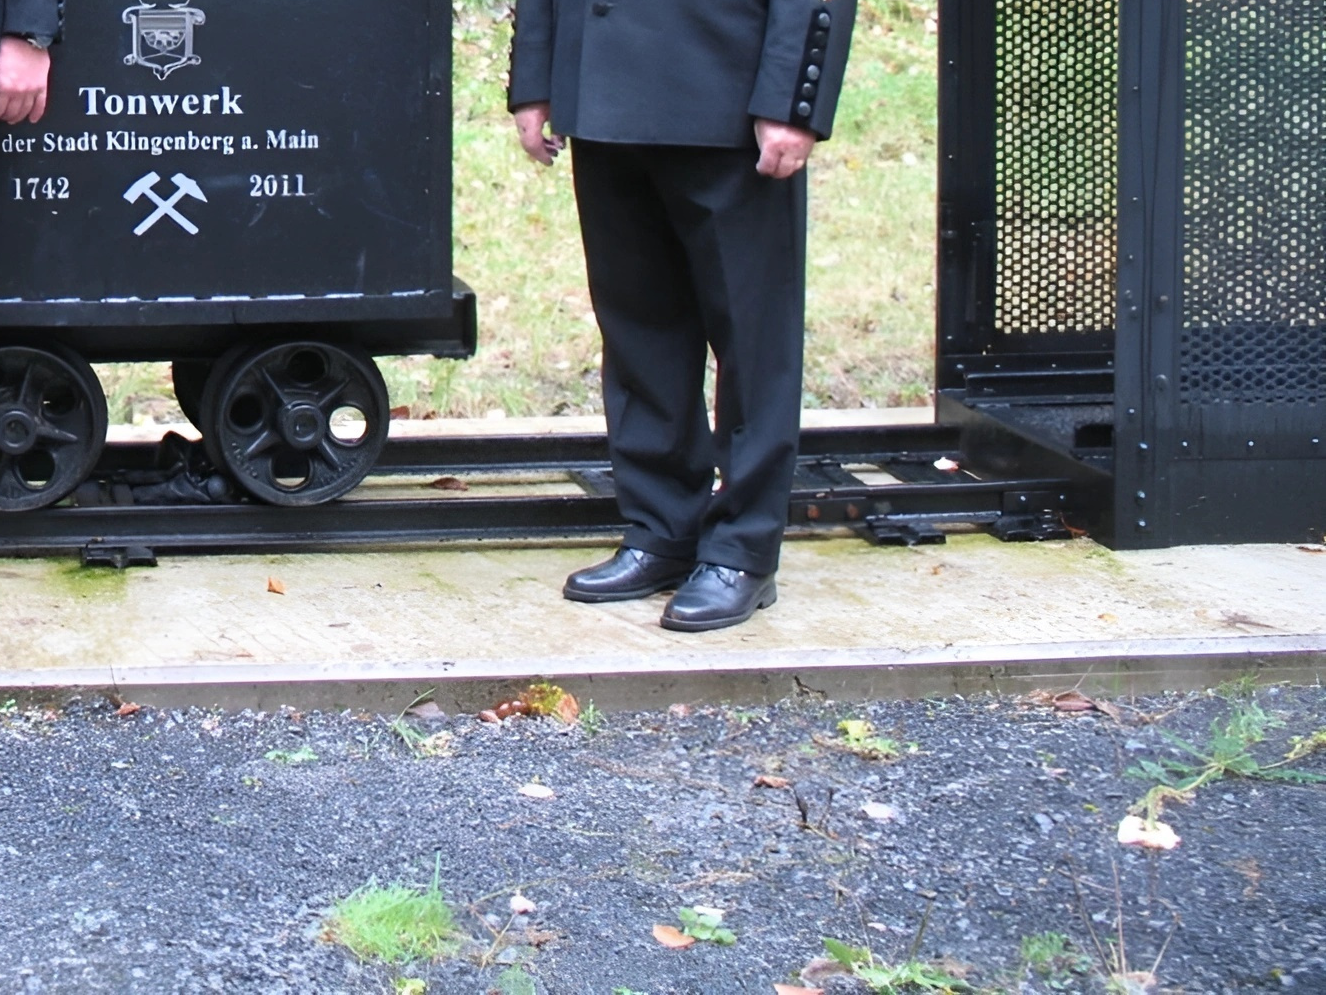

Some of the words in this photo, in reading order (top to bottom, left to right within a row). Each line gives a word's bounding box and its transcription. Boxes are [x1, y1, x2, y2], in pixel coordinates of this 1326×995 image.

[78, 86, 244, 116] Tonwerk
[1, 133, 35, 153] der
[42, 131, 98, 152] Stadt
[106, 130, 234, 155] Klingenberg
[266, 129, 319, 150] Main
[12, 176, 70, 200] 1742
[249, 174, 306, 197] 2011
